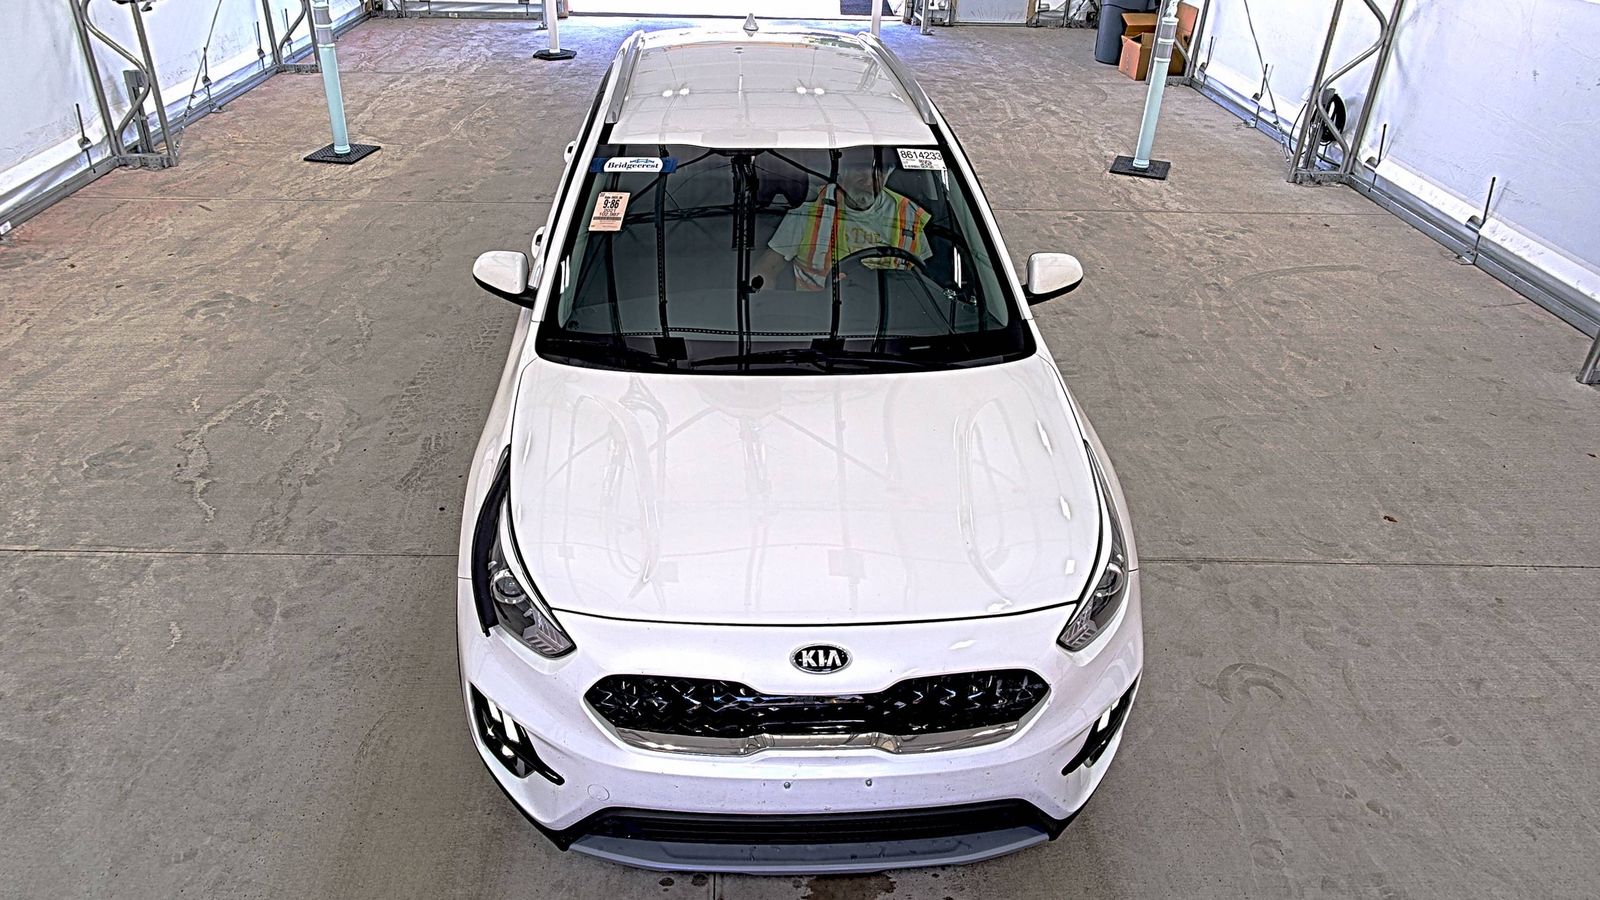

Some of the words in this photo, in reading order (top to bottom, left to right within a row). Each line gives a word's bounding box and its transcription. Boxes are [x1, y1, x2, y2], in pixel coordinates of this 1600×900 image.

[900, 150, 942, 160] 8614233
[607, 161, 659, 170] Bridgecrest
[603, 199, 620, 209] 9:86
[801, 649, 842, 667] KIA
